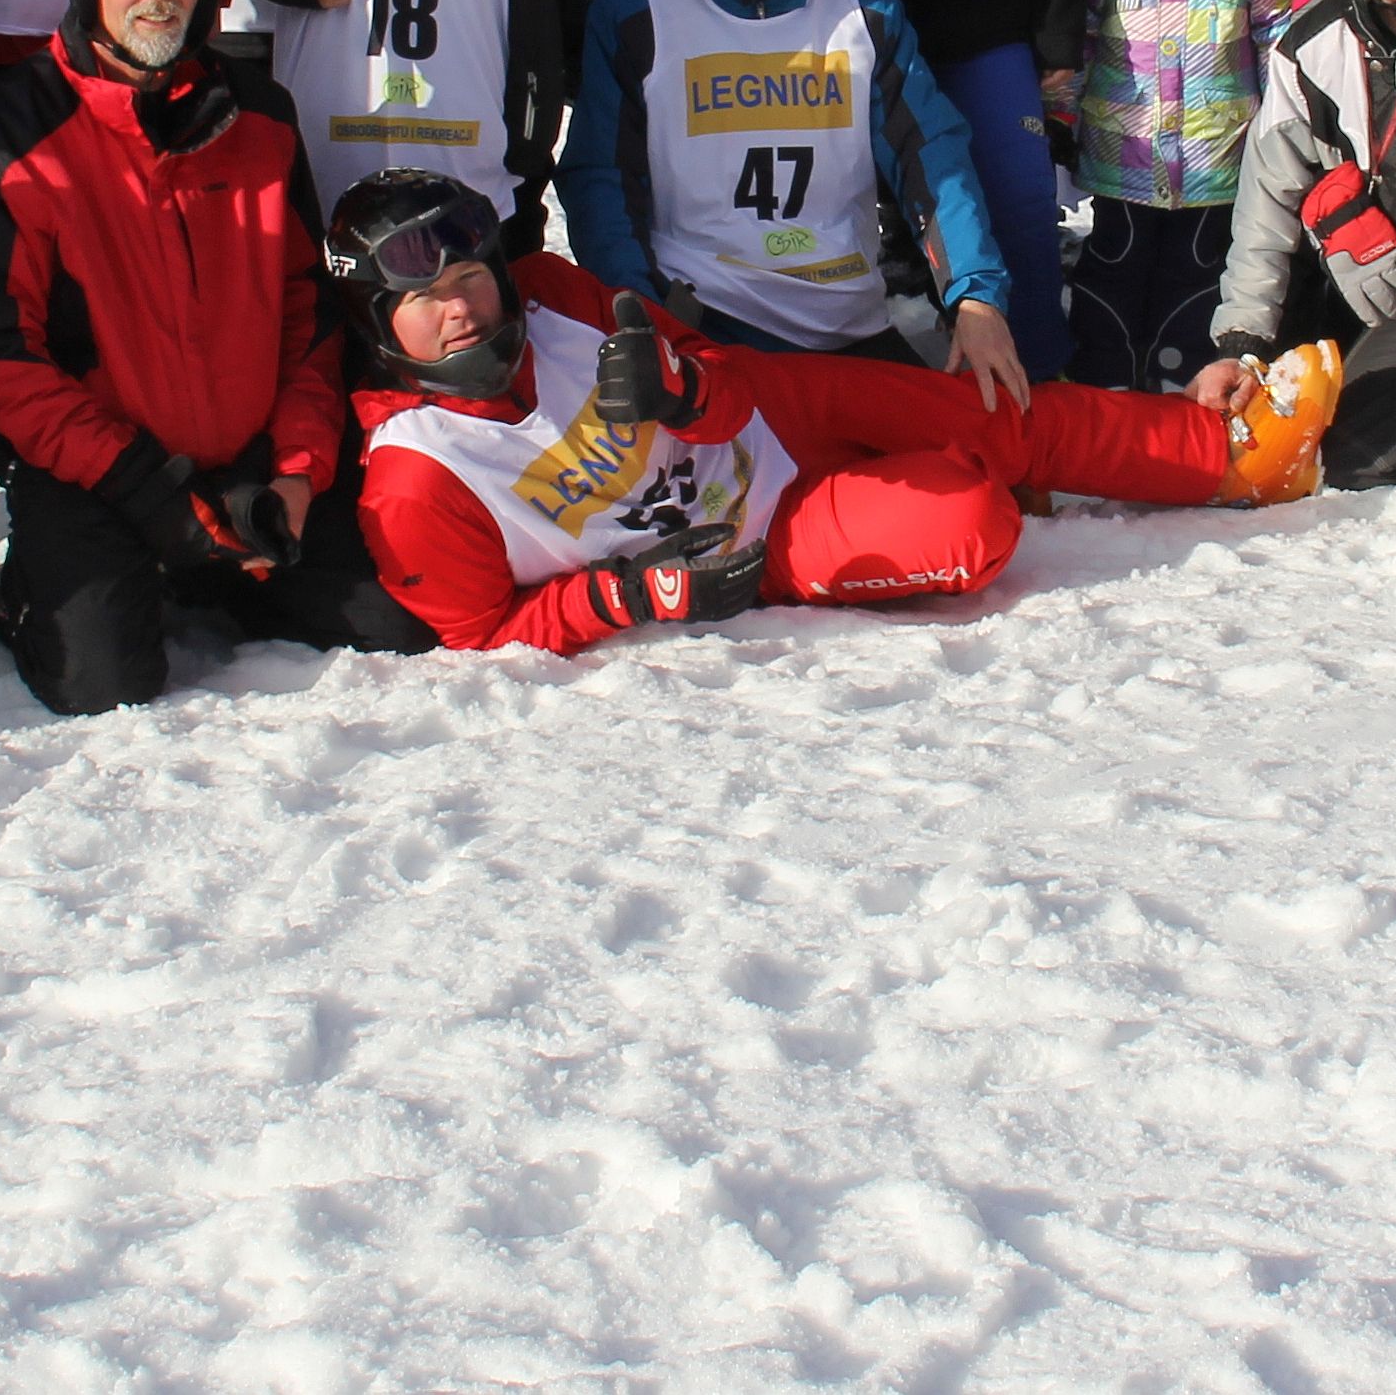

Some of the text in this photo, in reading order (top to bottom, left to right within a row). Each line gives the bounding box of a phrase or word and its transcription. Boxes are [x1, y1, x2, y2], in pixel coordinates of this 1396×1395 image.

[692, 73, 844, 114] LEGNICA
[734, 146, 814, 222] 47
[530, 421, 637, 522] LGNIC
[842, 565, 971, 591] POLSKA
